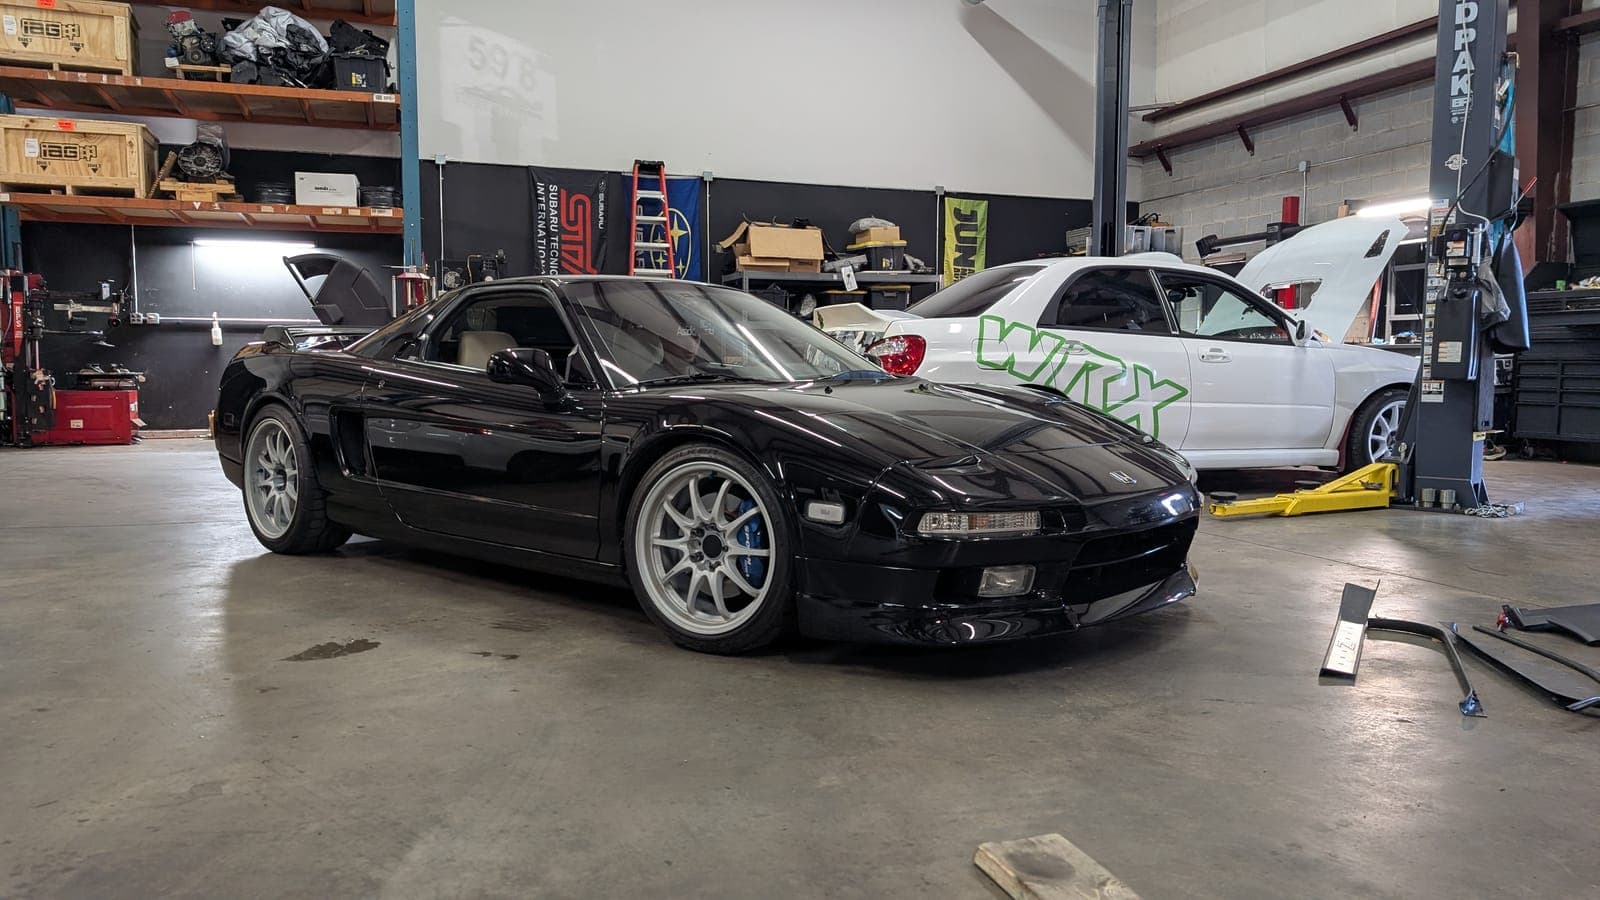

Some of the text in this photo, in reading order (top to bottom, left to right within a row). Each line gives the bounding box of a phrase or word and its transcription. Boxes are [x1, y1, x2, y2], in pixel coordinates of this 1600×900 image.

[1450, 0, 1479, 96] DPAK
[549, 184, 559, 233] SUBARU
[953, 206, 978, 268] JUN
